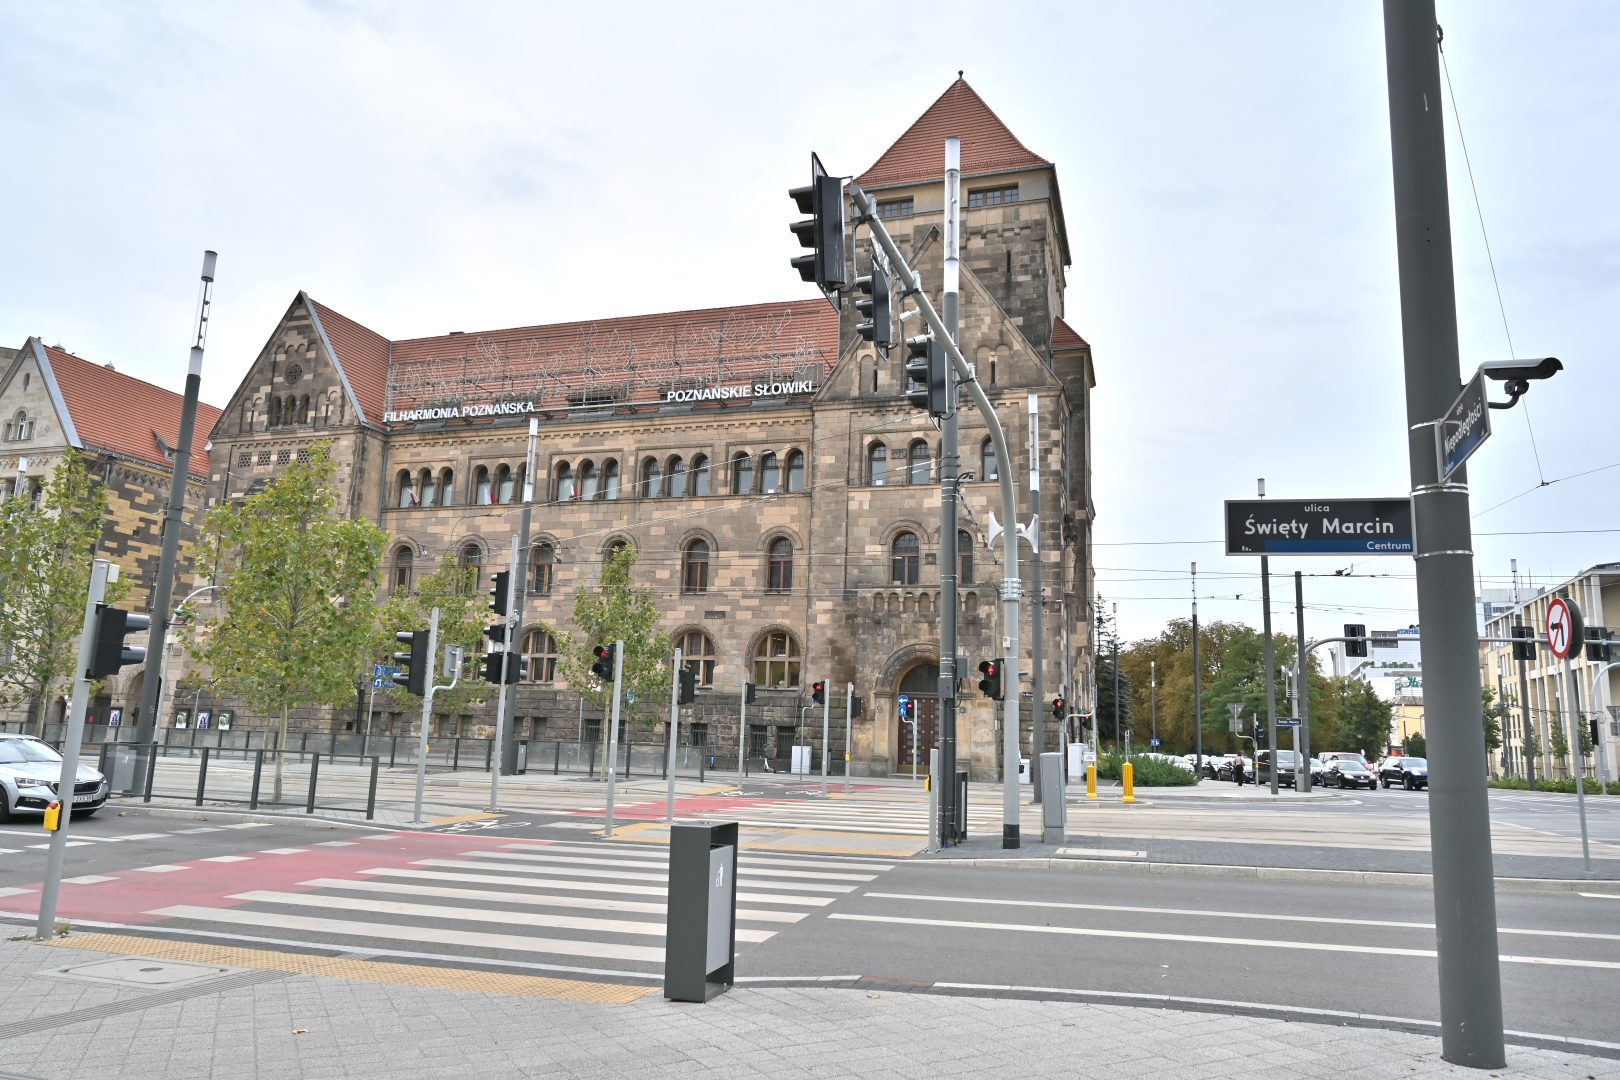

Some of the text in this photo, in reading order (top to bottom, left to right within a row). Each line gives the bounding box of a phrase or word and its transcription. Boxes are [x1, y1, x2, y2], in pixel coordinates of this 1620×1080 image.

[667, 380, 812, 402] POZNAŃSKIE SŁOWIKI
[384, 401, 535, 422] FILHARMONIA POZNAŃSKA
[1304, 504, 1330, 512] ulica
[1244, 514, 1394, 539] Święty Marcin
[1366, 541, 1411, 550] Centrum
